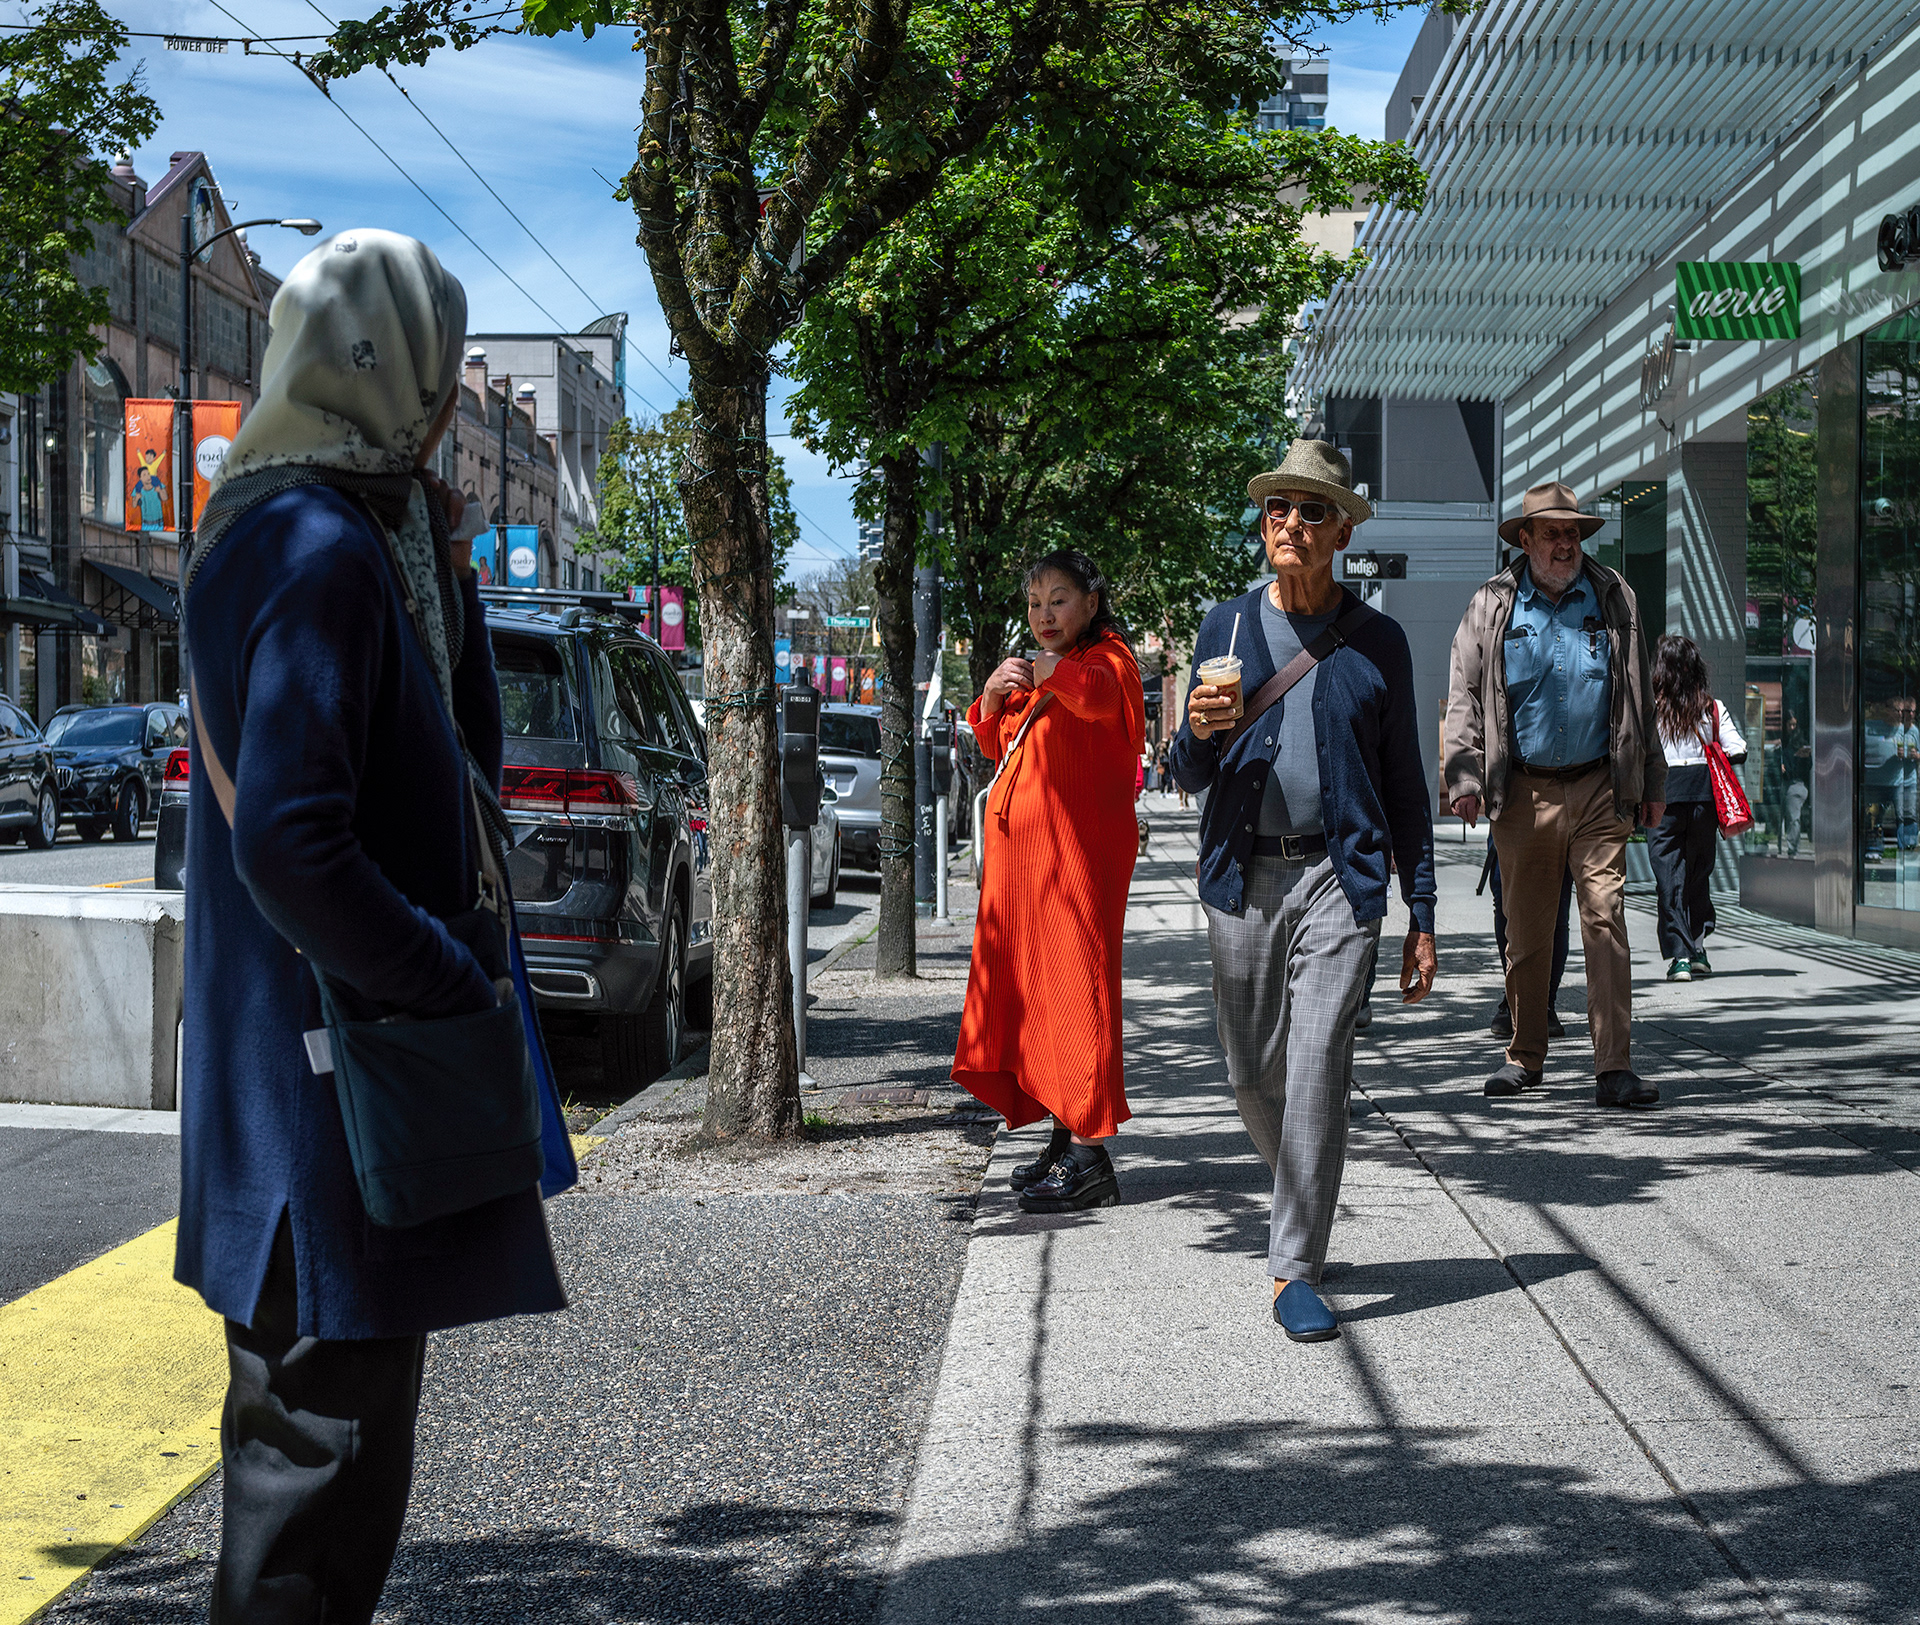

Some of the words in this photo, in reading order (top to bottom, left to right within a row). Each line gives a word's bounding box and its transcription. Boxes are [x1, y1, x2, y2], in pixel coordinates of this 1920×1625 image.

[167, 40, 201, 52] POWER
[206, 42, 224, 53] OFF
[1689, 275, 1786, 318] aerie
[830, 618, 857, 627] Thurlow
[859, 618, 867, 627] St
